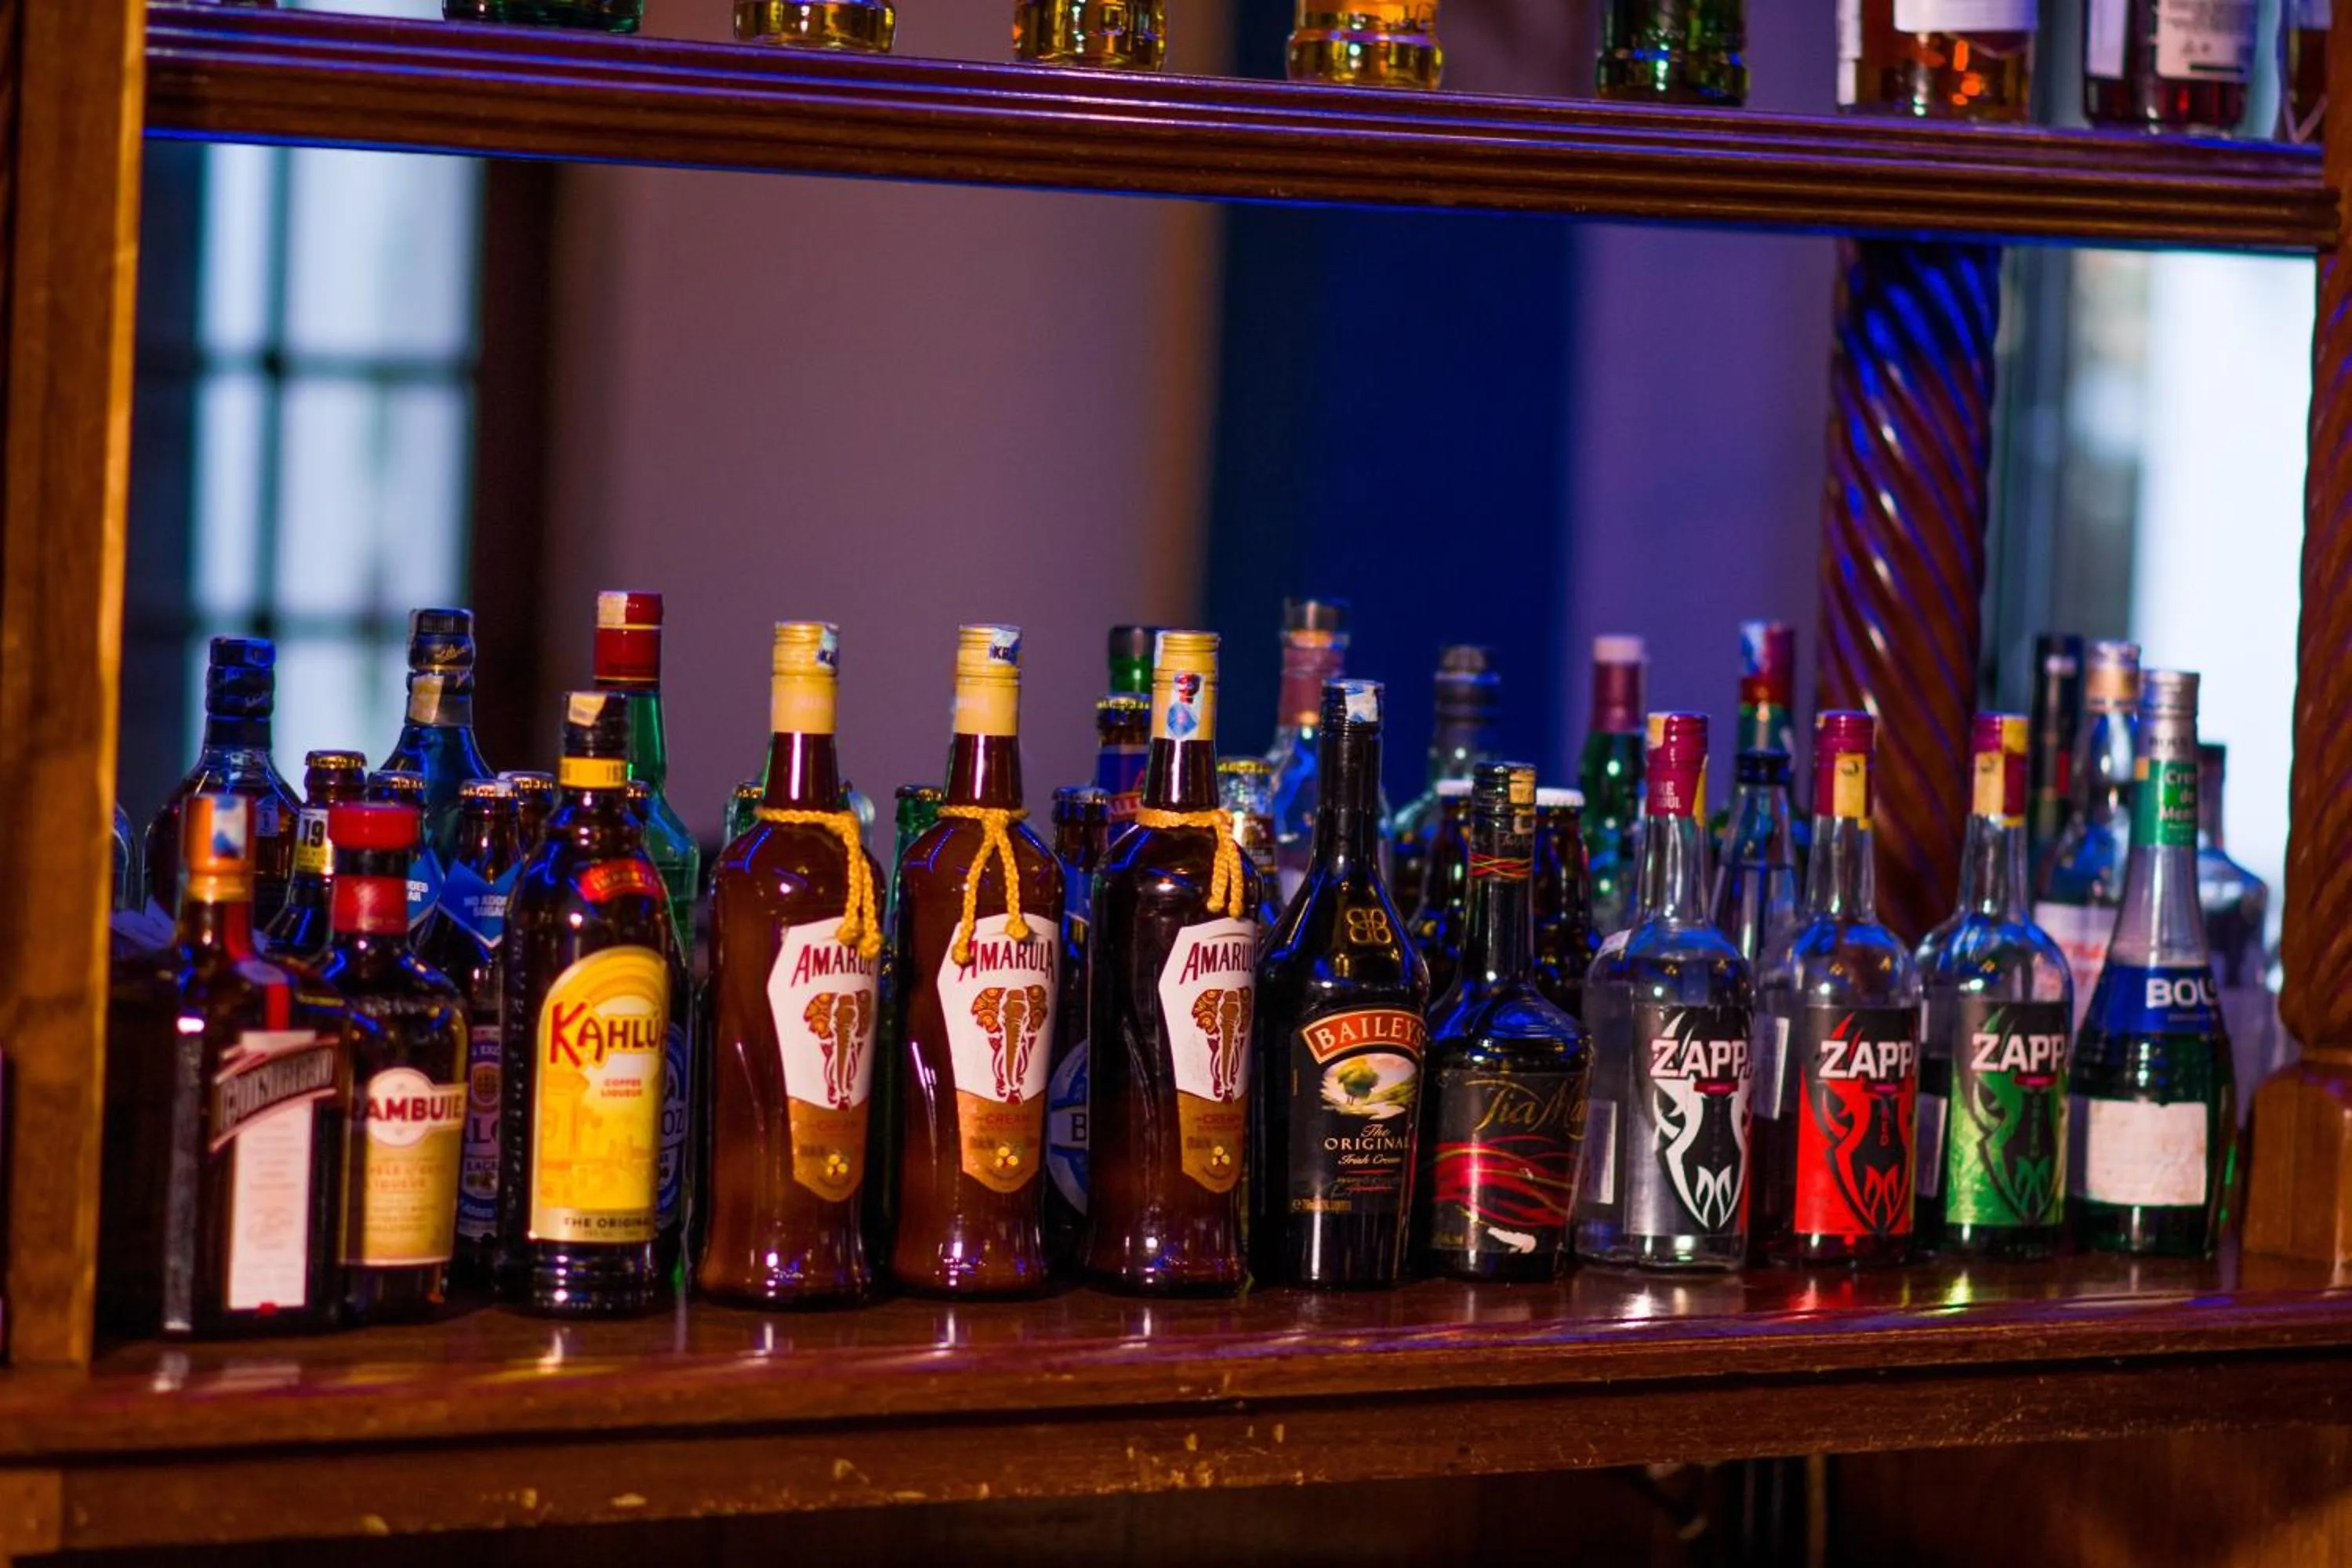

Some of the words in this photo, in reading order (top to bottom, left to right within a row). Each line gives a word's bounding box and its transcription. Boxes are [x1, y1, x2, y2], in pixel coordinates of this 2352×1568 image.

[958, 940, 1054, 982] AMARULA
[1315, 1017, 1423, 1051] BAILEYS
[1465, 1080, 1545, 1131] Tia
[1324, 1137, 1410, 1151] ORIGINAL
